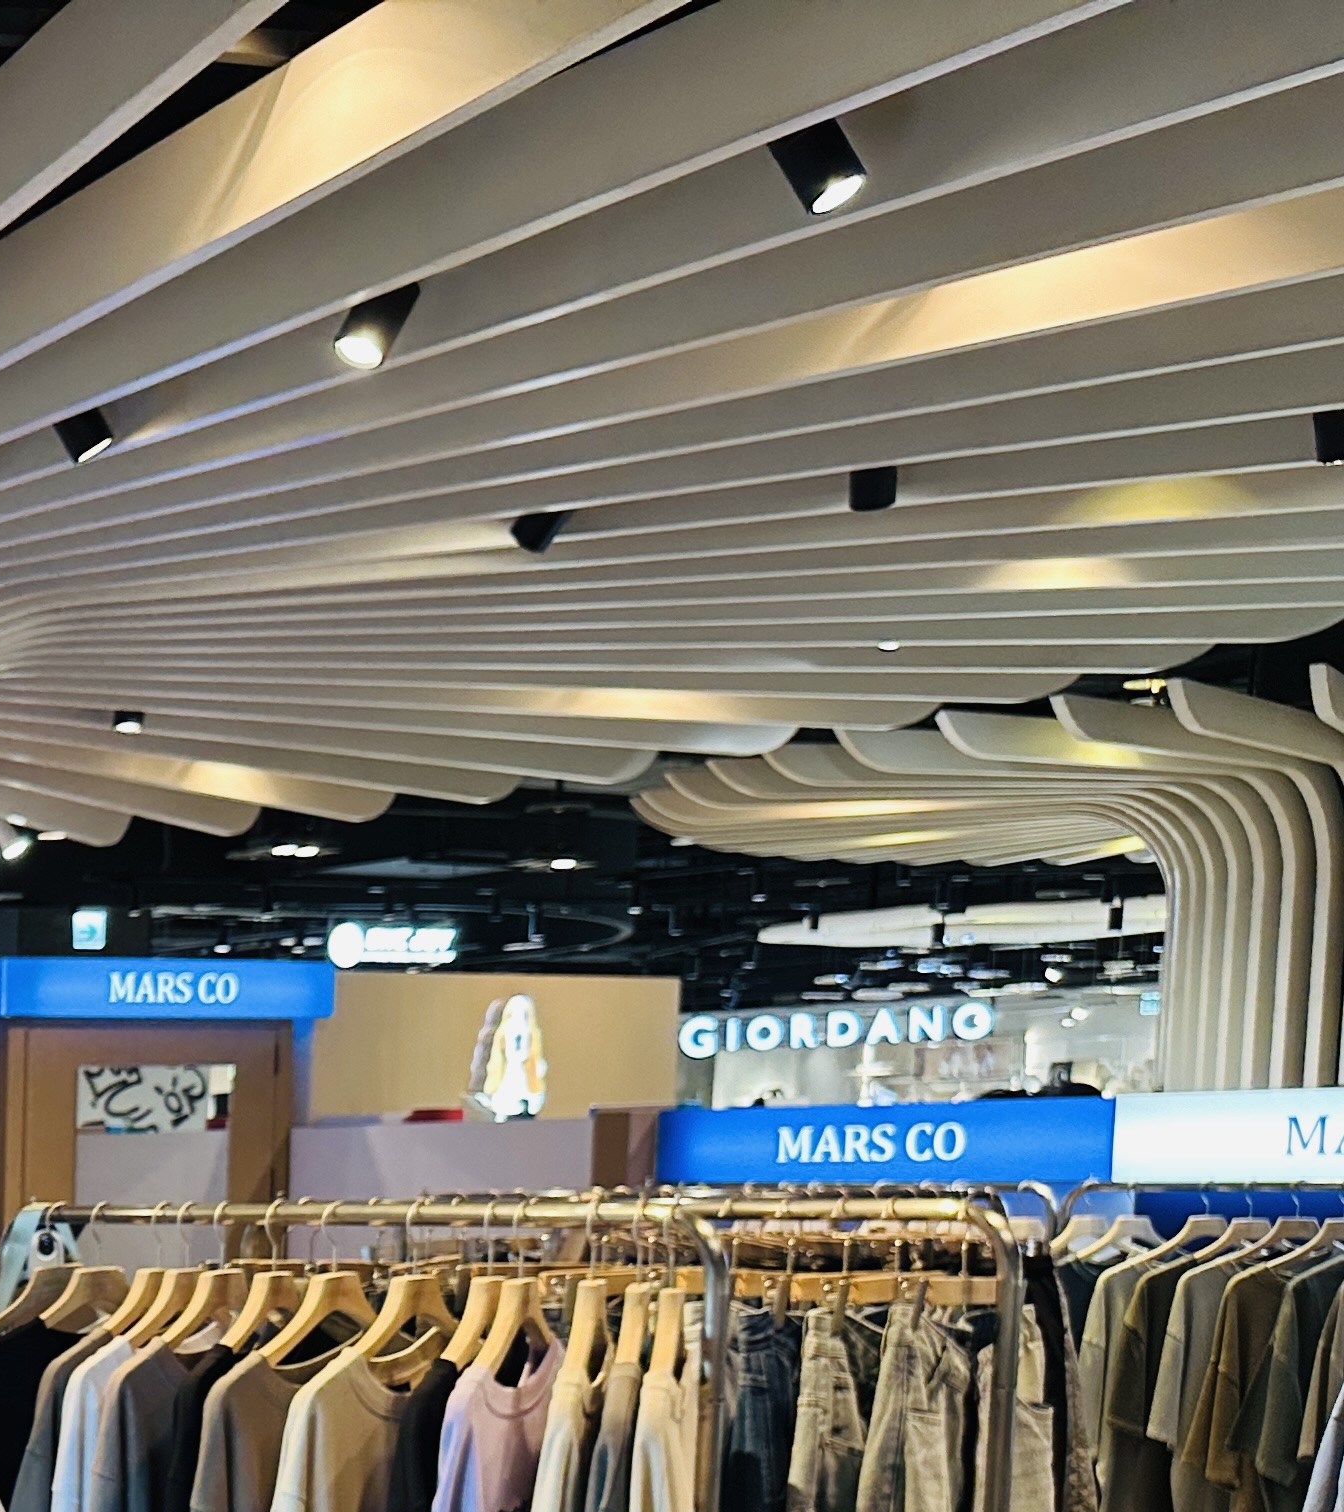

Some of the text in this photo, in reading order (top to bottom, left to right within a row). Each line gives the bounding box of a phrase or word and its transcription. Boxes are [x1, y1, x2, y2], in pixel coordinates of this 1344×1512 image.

[109, 971, 239, 1004] MARS CO
[678, 1001, 994, 1059] GIORDANO
[776, 1121, 967, 1163] MARS CO
